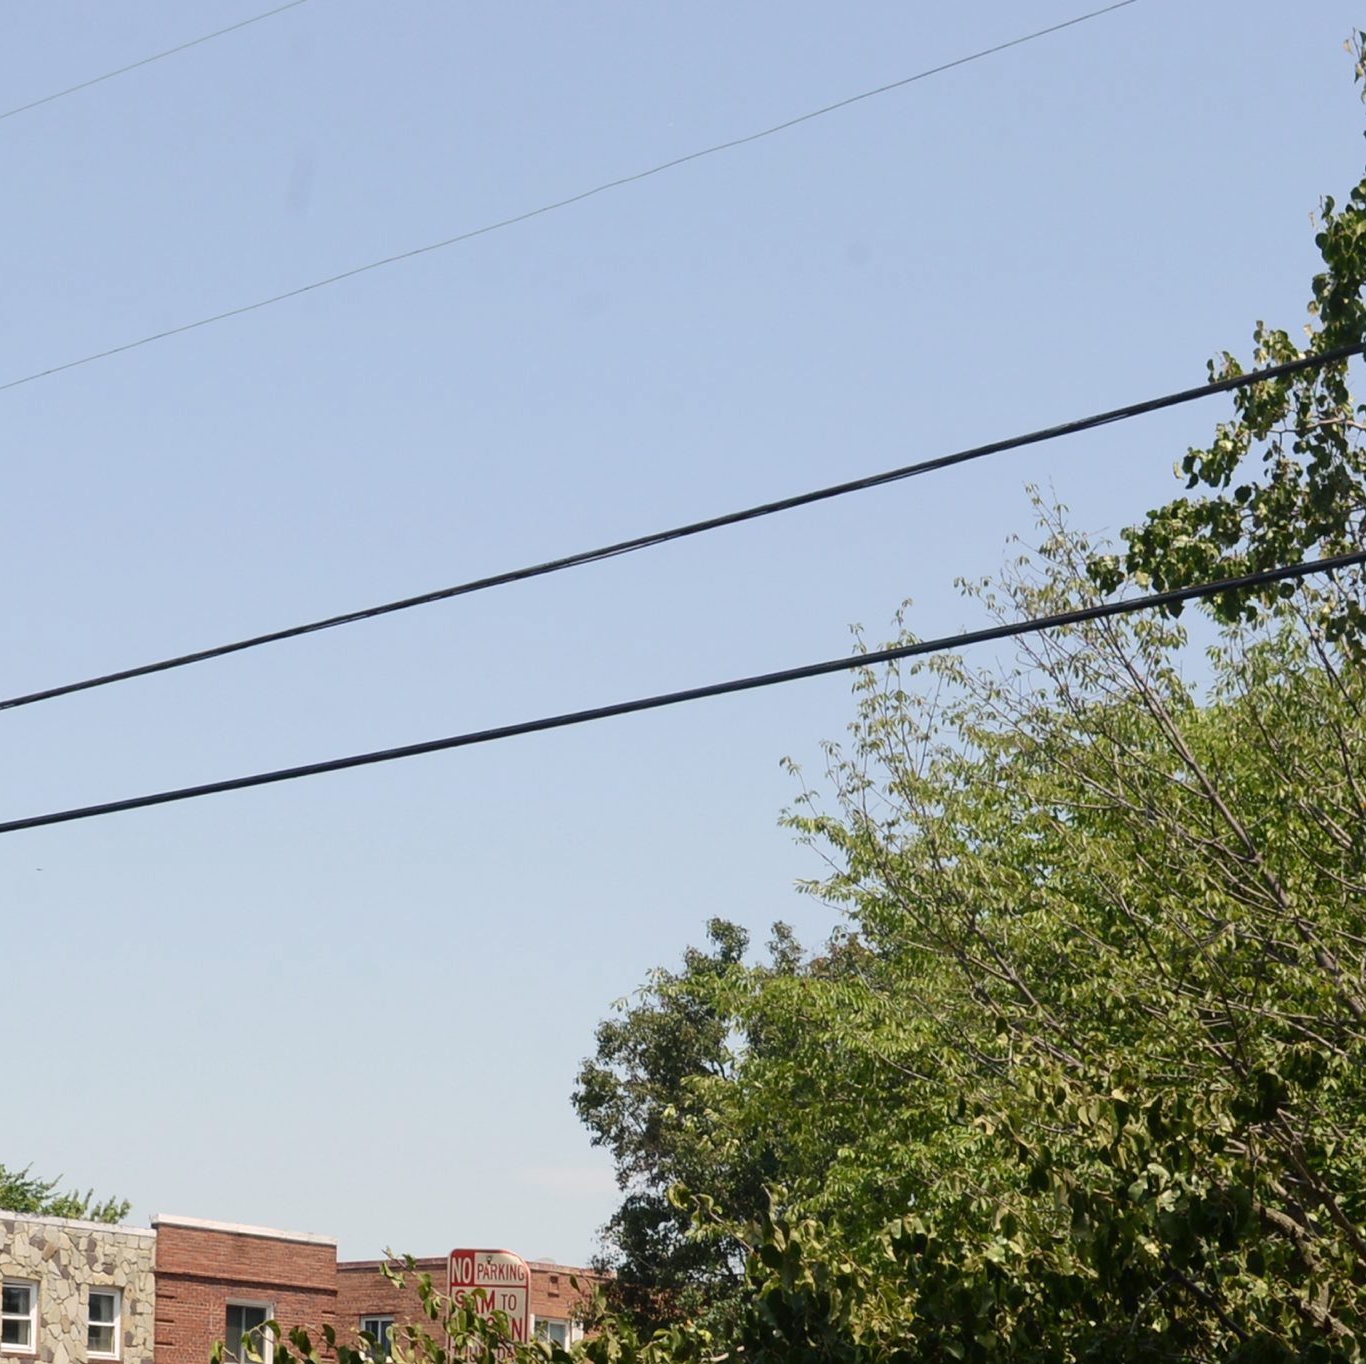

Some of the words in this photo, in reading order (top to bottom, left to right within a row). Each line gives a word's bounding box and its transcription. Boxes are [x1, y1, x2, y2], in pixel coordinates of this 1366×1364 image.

[452, 1257, 473, 1284] NO
[477, 1263, 525, 1281] PARKING
[501, 1293, 517, 1311] TO
